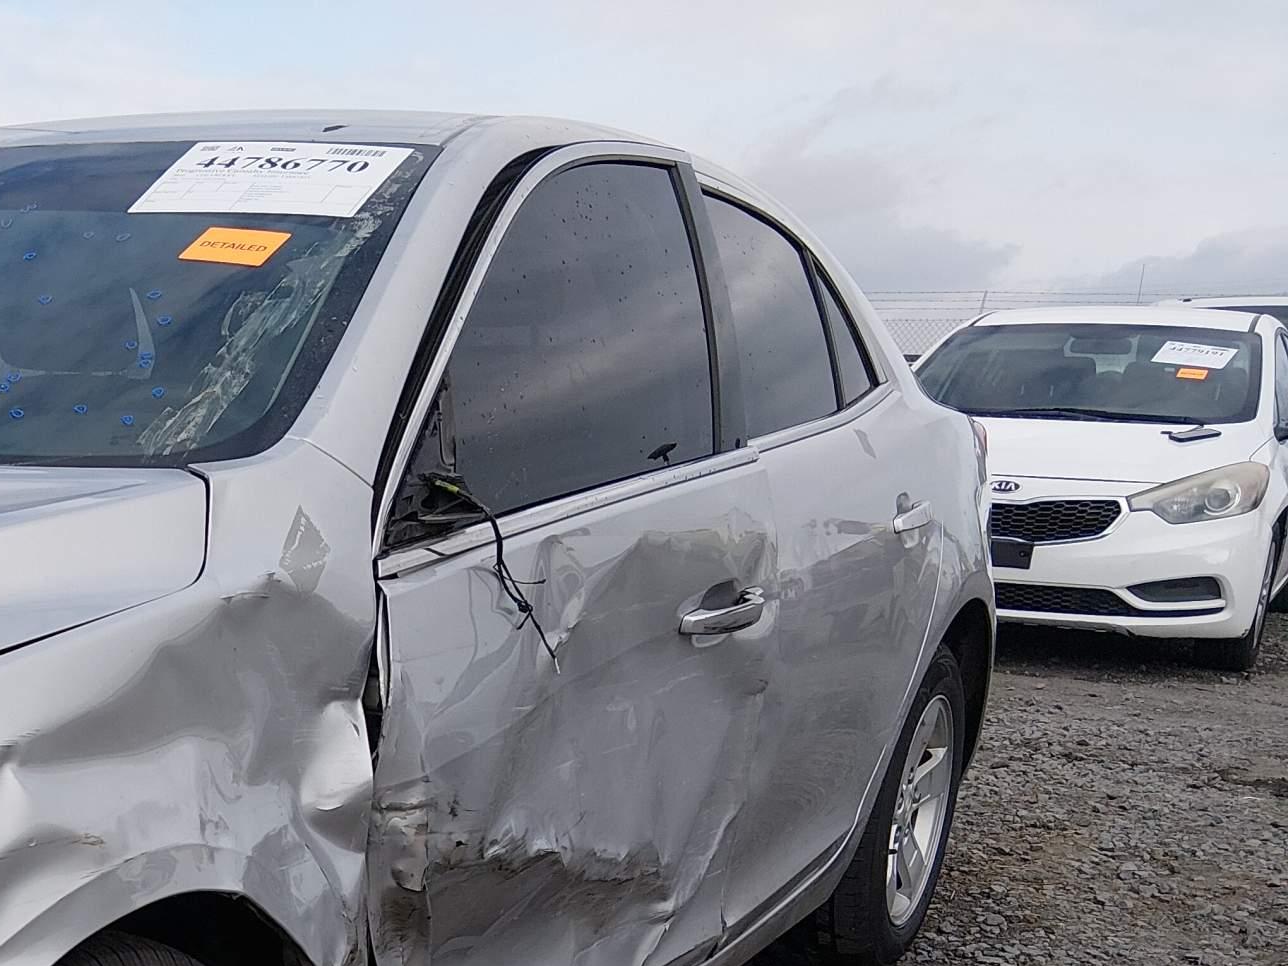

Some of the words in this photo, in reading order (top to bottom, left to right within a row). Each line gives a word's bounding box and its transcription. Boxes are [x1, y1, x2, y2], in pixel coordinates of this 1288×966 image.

[196, 156, 369, 173] 44786770
[199, 240, 268, 252] DETAILED
[991, 482, 1016, 490] KIA
